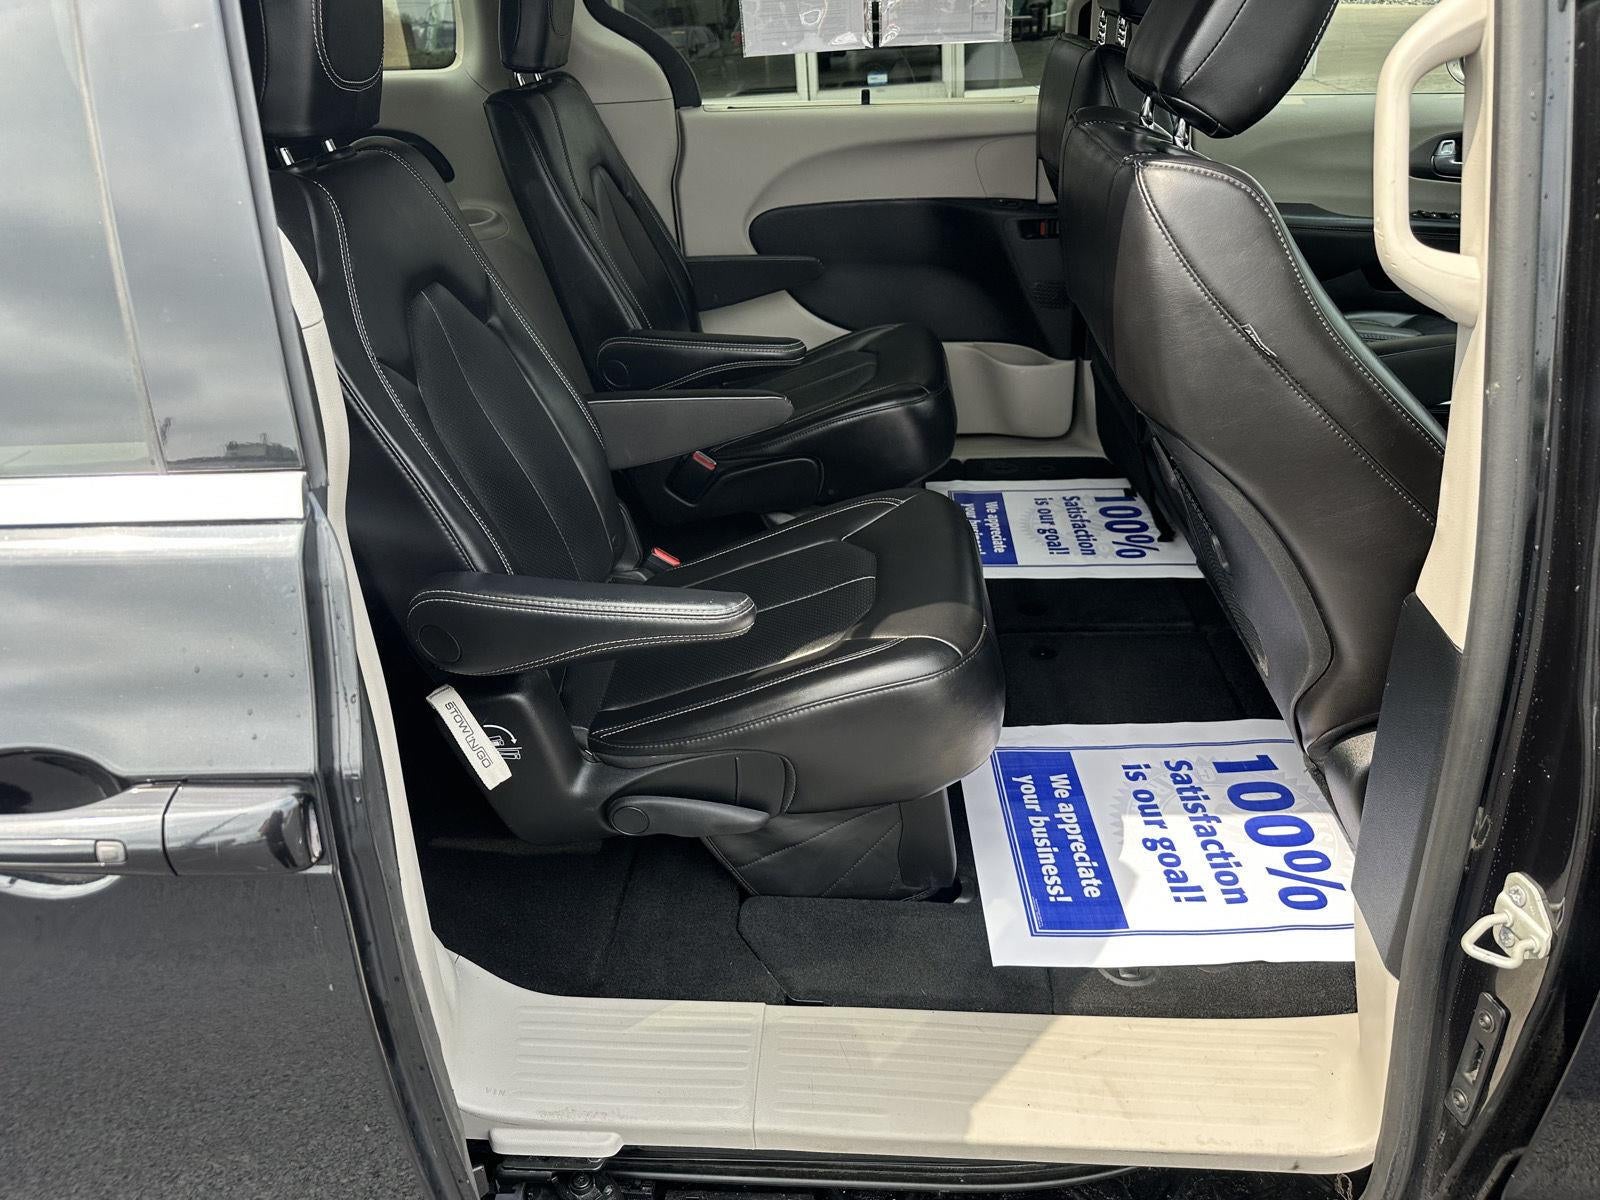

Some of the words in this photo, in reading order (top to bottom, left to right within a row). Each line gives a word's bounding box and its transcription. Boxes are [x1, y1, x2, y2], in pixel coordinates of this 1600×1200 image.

[984, 501, 999, 513] We
[1034, 497, 1054, 506] is
[1037, 508, 1059, 526] our
[984, 514, 1007, 553] appreciate
[1037, 527, 1071, 556] goal!
[1062, 496, 1097, 556] Satisfaction
[1094, 496, 1159, 559] 100%
[1049, 773, 1073, 799] We
[1121, 764, 1151, 782] is
[1131, 788, 1167, 830] our
[1012, 775, 1042, 812] your
[1029, 816, 1073, 902] business!
[1054, 802, 1103, 898] appreciate
[1164, 760, 1249, 905] Satisfaction
[1213, 754, 1346, 910] 100%
[1142, 837, 1206, 903] goal!
